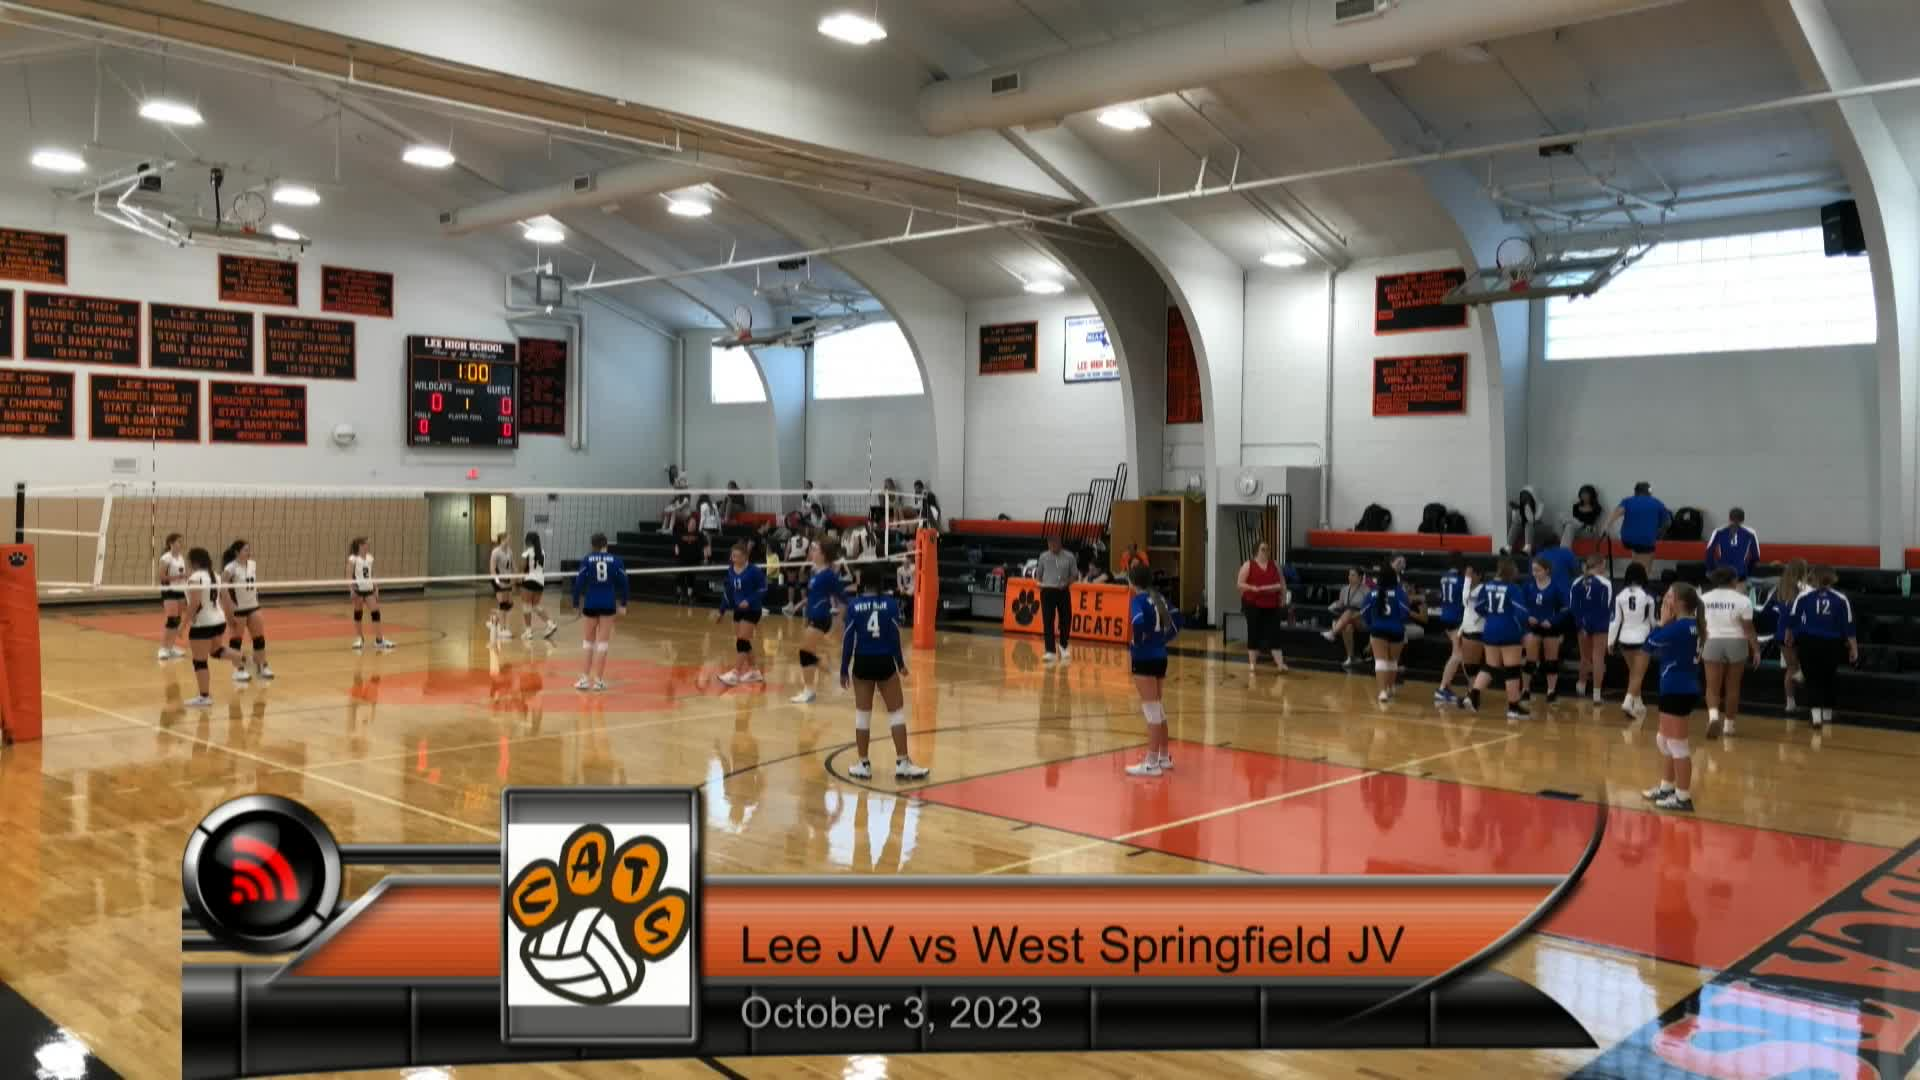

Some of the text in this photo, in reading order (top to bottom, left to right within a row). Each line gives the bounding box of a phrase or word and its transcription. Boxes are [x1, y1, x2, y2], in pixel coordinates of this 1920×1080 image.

[47, 296, 119, 312] LEE HIGH
[32, 320, 134, 337] STATE CHAMPIONS
[34, 333, 130, 350] GIRLS BASKETBALL
[157, 331, 248, 347] STATE CHAMPIONS
[271, 340, 350, 355] STATE CHAMPIONS
[424, 337, 505, 354] LEE HIGH SCHOOL
[160, 343, 245, 360] GIRLS BASKETBALL
[299, 353, 348, 366] BASKETBALL
[459, 362, 489, 382] 1:00
[414, 380, 511, 395] WILDCATS GUEST
[9, 398, 64, 410] CHAMPIONS
[103, 401, 188, 416] STATE CHAMPIONS
[431, 392, 443, 412] 0
[501, 397, 512, 416] 0
[4, 409, 60, 423] BASKETBALL
[133, 415, 187, 428] BASKETBALL
[419, 419, 429, 435] 0
[503, 422, 512, 437] 0
[596, 561, 608, 582] 8
[1079, 591, 1104, 611] EE
[1441, 583, 1454, 603] 11
[854, 601, 871, 611] WEST
[1487, 591, 1506, 614] 17
[1816, 598, 1831, 616] 12
[866, 610, 881, 638] 4
[1071, 614, 1123, 637] DCATS
